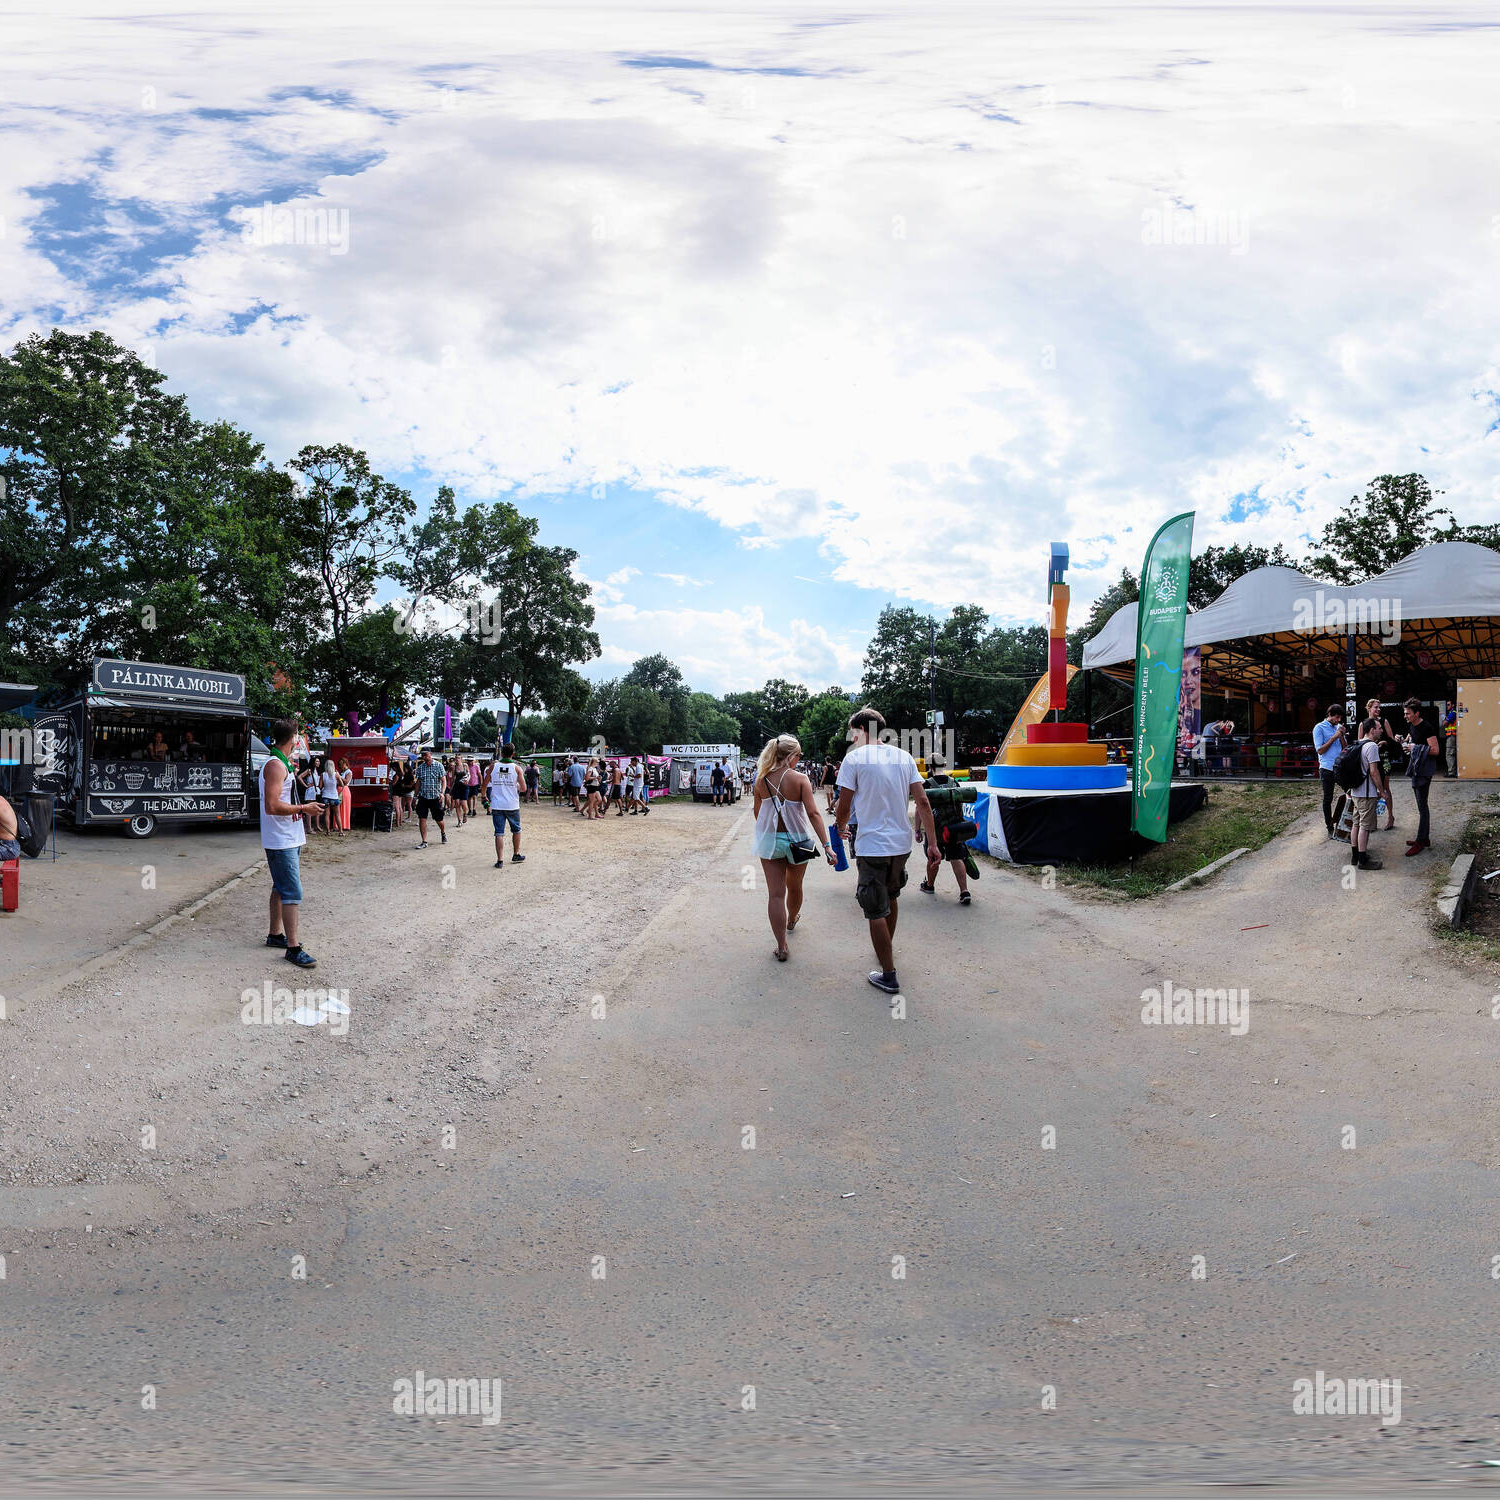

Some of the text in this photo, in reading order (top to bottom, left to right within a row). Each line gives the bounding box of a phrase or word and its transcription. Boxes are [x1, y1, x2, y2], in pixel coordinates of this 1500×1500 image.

[1149, 606, 1182, 616] BUDAPEST
[111, 666, 233, 695] PÁLINKAMOBIL
[1139, 690, 1148, 727] MINDENT
[689, 745, 720, 753] TOILETS
[142, 800, 160, 811] THE
[161, 798, 198, 811] PÁLINKA
[200, 800, 216, 810] BAR
